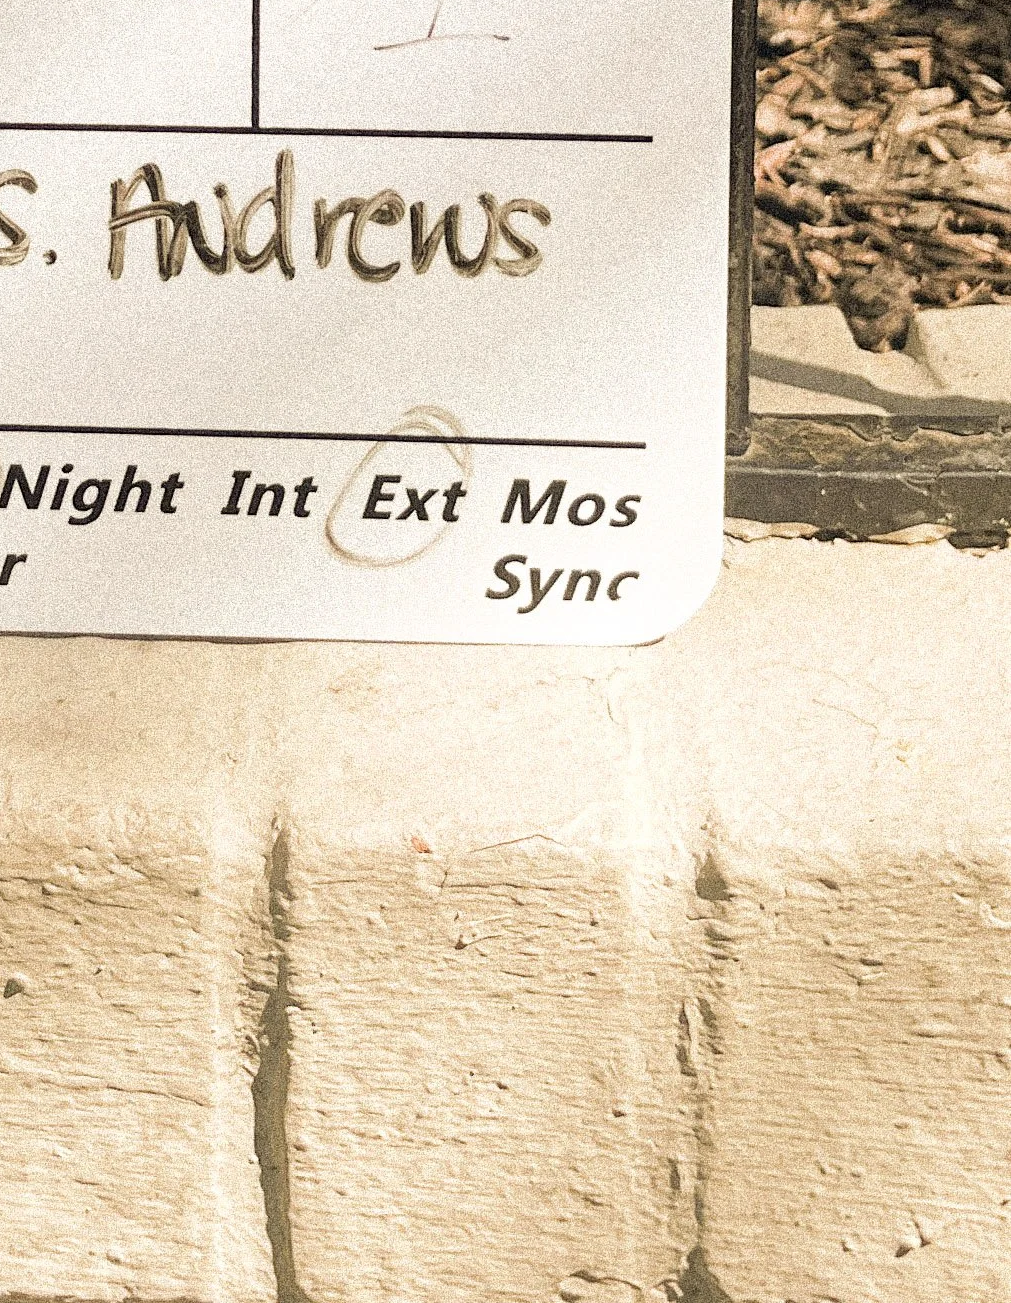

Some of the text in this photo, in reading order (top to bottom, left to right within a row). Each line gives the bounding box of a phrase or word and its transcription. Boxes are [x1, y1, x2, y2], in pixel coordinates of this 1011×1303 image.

[108, 149, 552, 282] Andrews
[220, 469, 318, 518] Int
[362, 474, 468, 523] Ext
[500, 479, 641, 528] Mos
[484, 554, 639, 614] Sync
